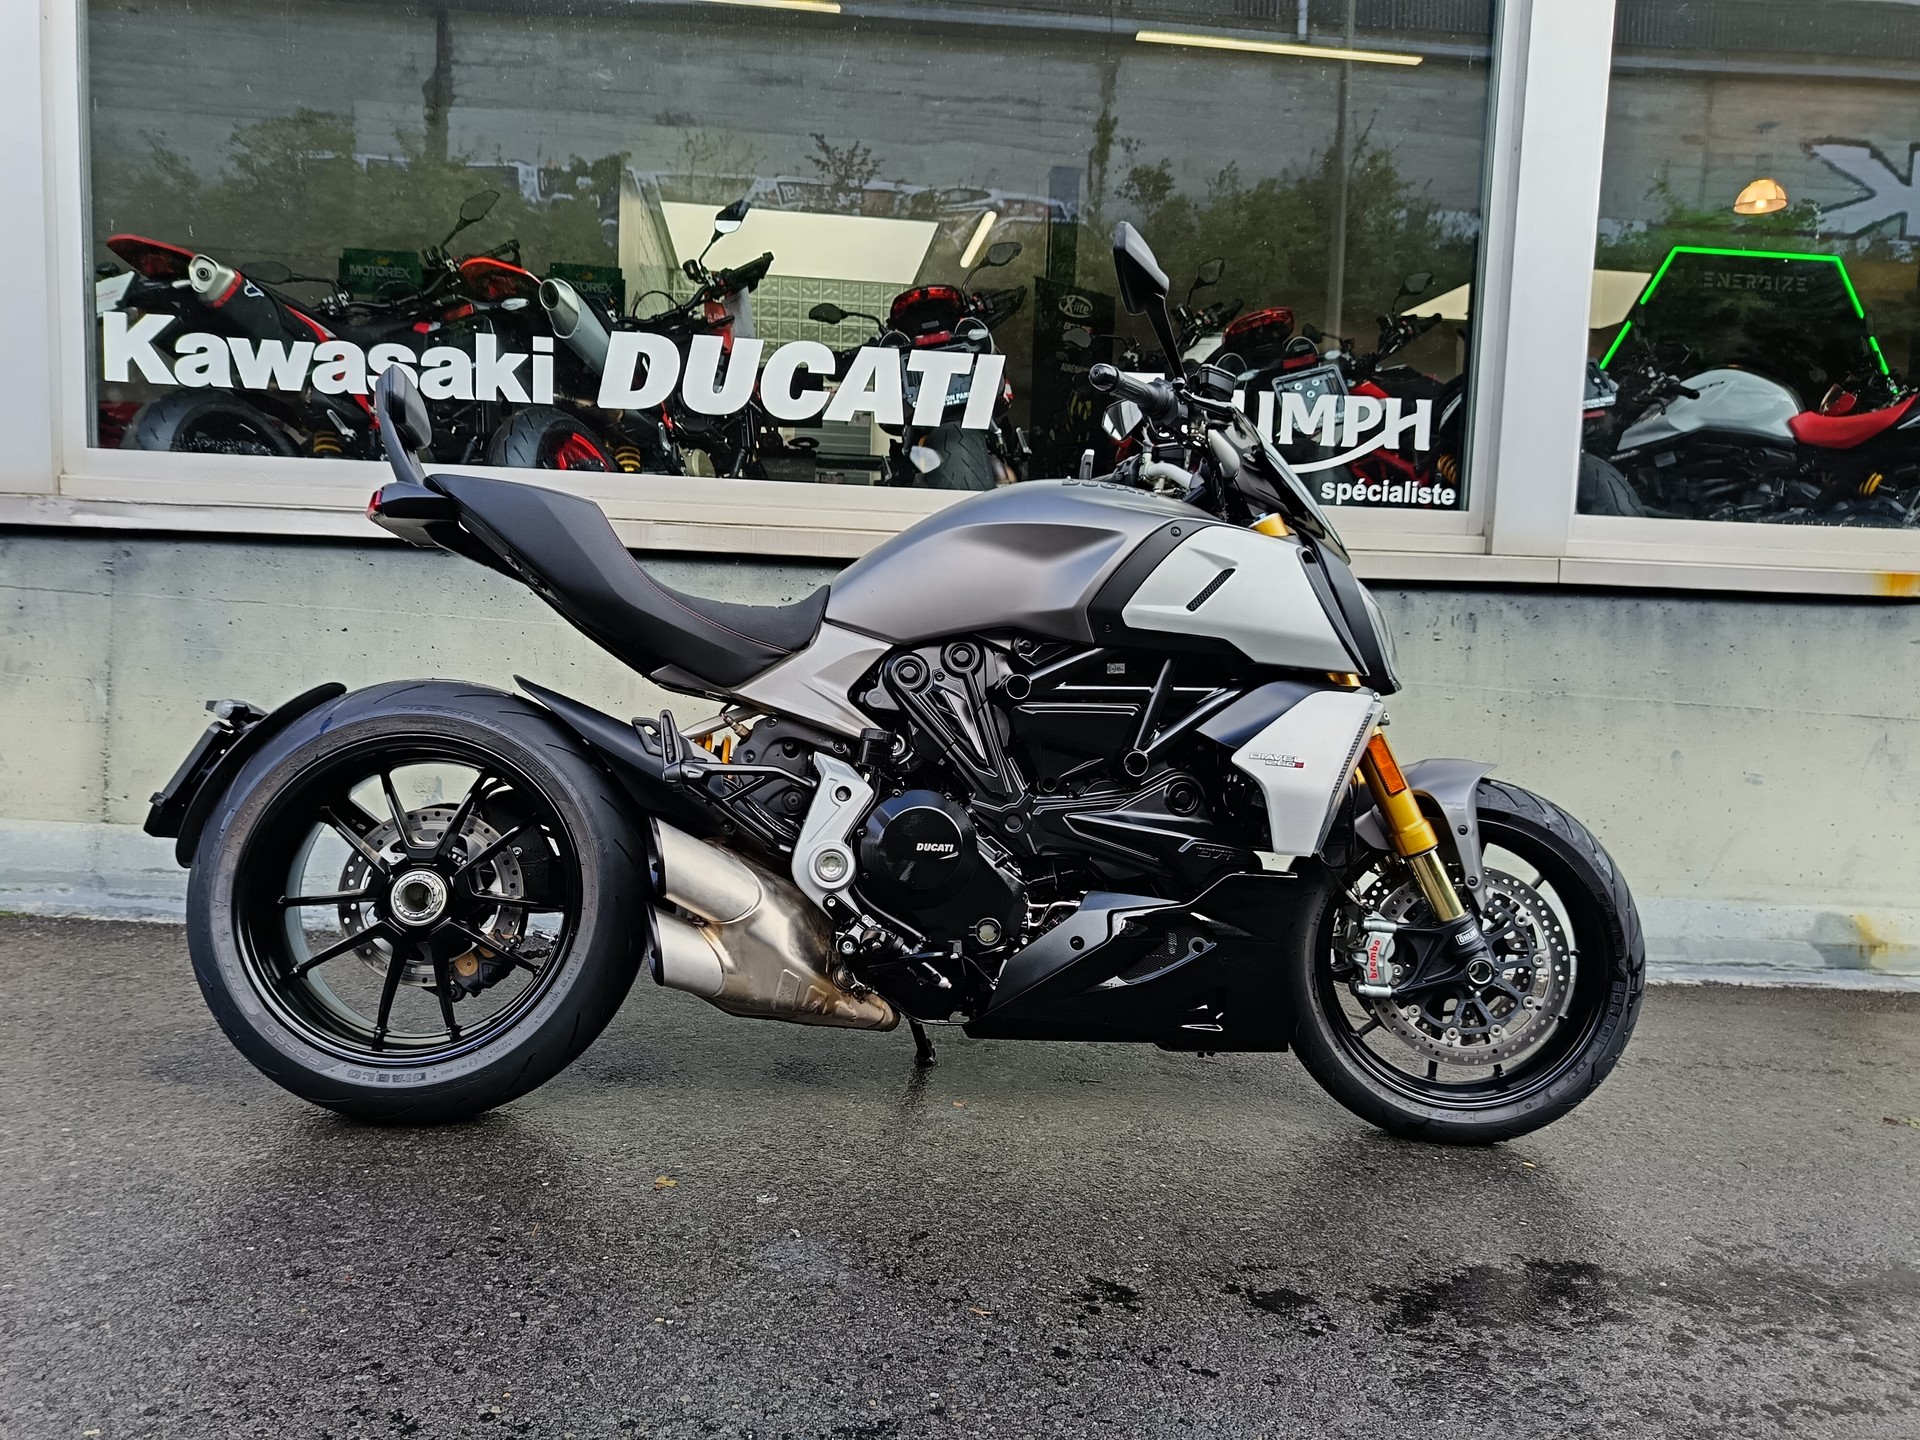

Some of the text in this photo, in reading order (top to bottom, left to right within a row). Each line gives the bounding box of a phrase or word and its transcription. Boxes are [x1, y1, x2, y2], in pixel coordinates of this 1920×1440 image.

[349, 264, 411, 279] MOTOREX
[1702, 270, 1808, 293] ENERGIZE
[573, 281, 614, 295] TOREX
[102, 310, 555, 405] Kawasaki
[596, 330, 1007, 430] DUCATI
[1320, 476, 1456, 507] spécialiste
[916, 842, 954, 853] DUCATI
[1368, 939, 1381, 981] brembo
[263, 1022, 322, 1069] ROSSO
[346, 1067, 427, 1085] DIABLO
